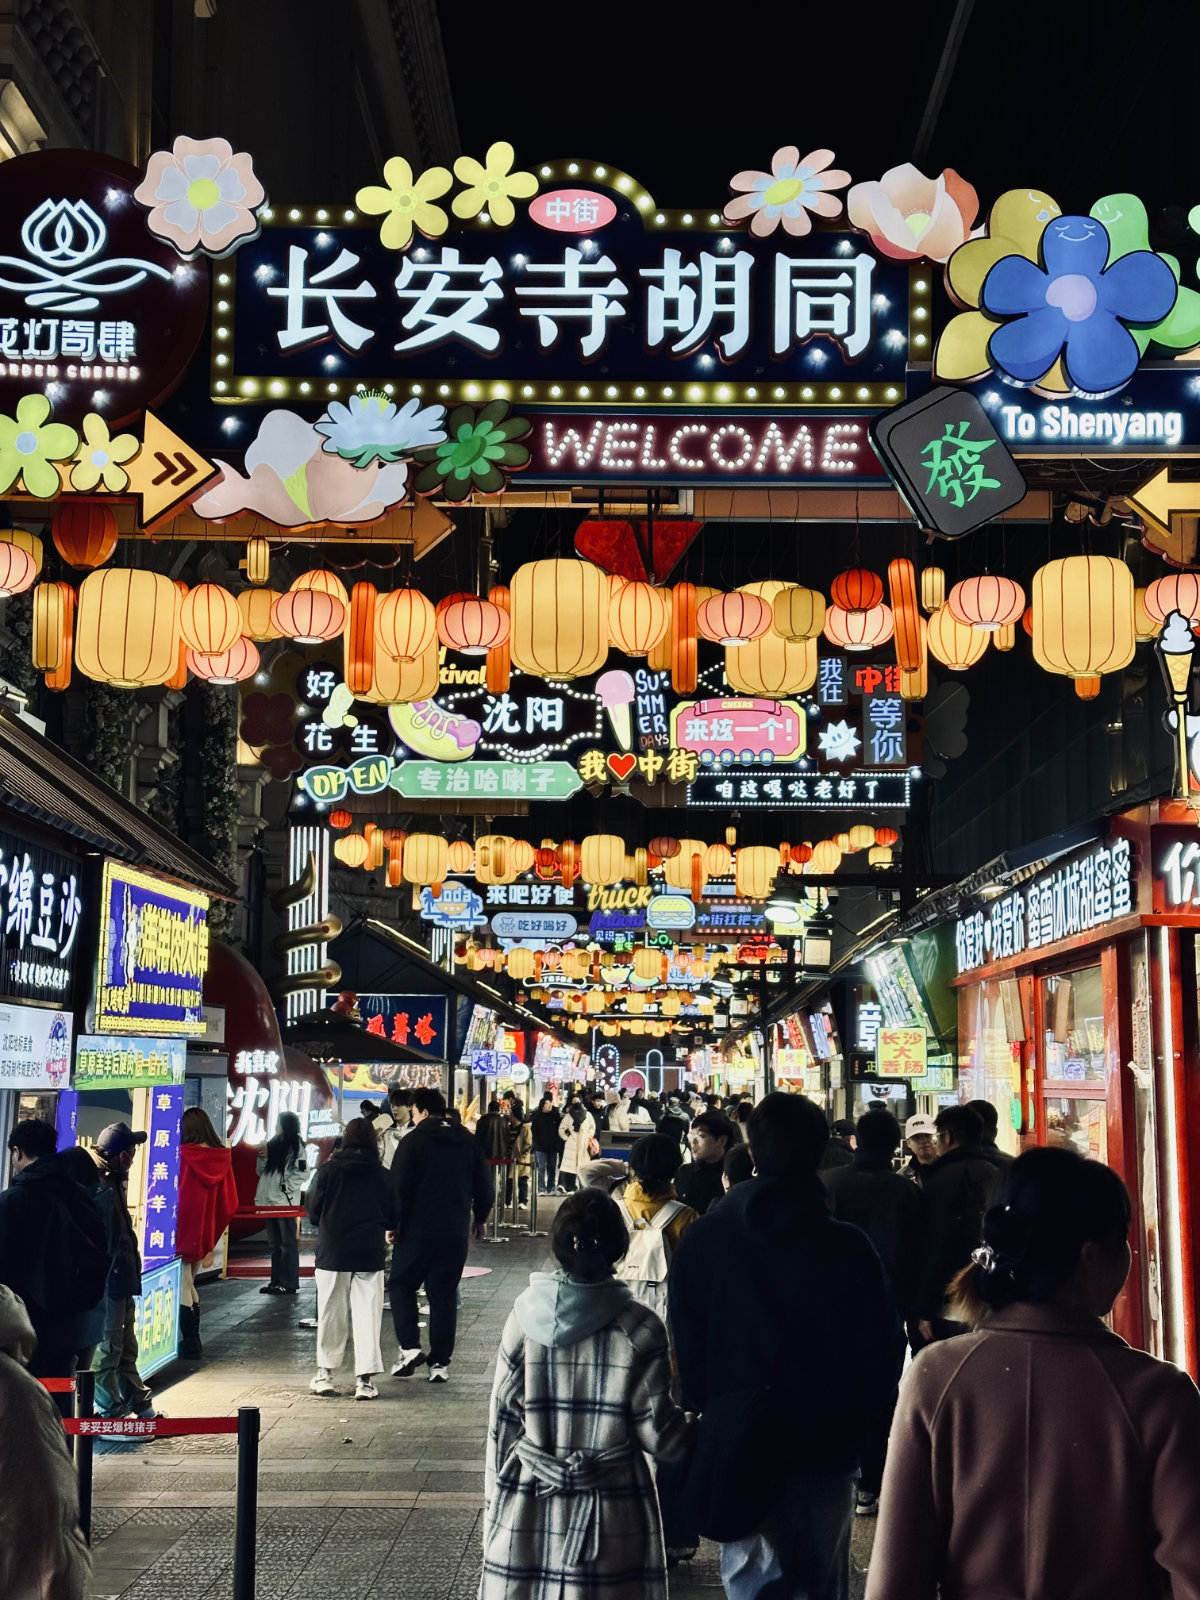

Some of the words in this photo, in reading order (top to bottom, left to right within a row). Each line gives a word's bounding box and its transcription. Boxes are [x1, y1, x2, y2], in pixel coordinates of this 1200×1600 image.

[545, 197, 600, 225] 中街
[267, 244, 877, 358] 长安寺胡同
[66, 364, 140, 379] CHEERS
[1001, 405, 1036, 437] To
[1043, 405, 1182, 445] Shenyang
[543, 421, 860, 471] WELCOME
[920, 421, 1001, 508] 發
[439, 663, 487, 685] tival
[820, 658, 843, 702] 我在
[482, 693, 564, 734] 沈阳
[721, 700, 754, 709] CHEERS
[640, 734, 669, 747] DAYS
[684, 718, 793, 742] 来炫一个!
[869, 698, 903, 764] 等你
[313, 760, 387, 796] OPEN
[417, 767, 556, 793] 专治哈喇子
[715, 780, 881, 799] 咱这嘎哒老好了
[0, 852, 81, 959] 绵豆沙
[992, 891, 1025, 961] 我爱你
[1028, 837, 1131, 949] 蜜雪冰城甜蜜蜜
[518, 920, 567, 932] 吃好喝好
[697, 913, 765, 926] 中街扛把子
[882, 1032, 923, 1045] 长沙
[893, 1046, 912, 1060] 大
[882, 1060, 924, 1074] 香肠
[80, 1421, 156, 1433] 李妥妥爆烤猪手
